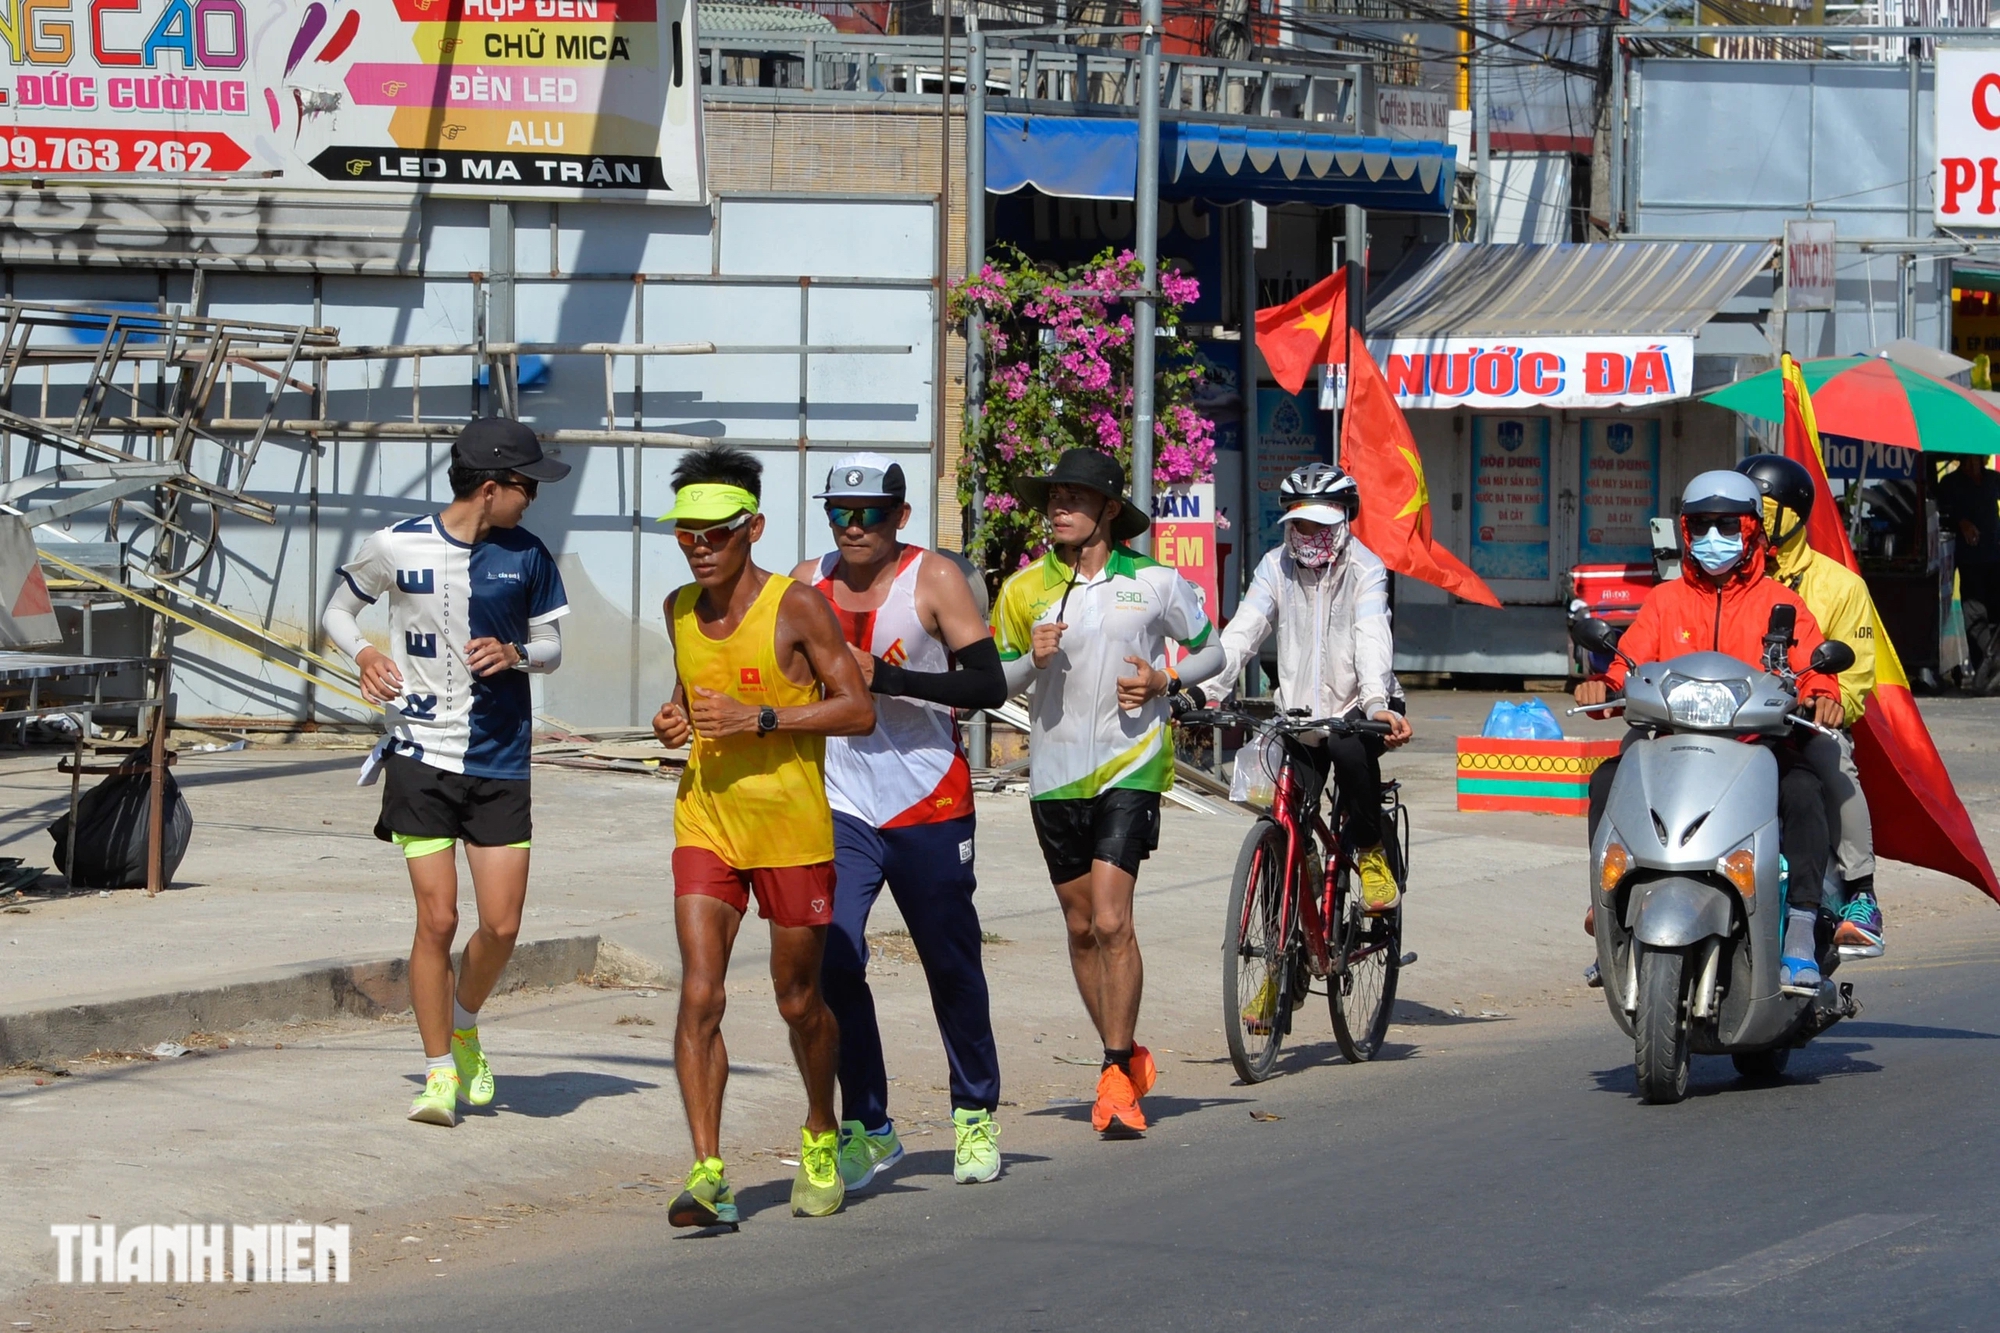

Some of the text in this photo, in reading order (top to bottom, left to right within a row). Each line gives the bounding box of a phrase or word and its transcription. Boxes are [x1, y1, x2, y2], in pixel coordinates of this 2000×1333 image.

[484, 28, 630, 61] CHỮ MICA
[16, 71, 249, 116] ĐỨC CƯỜNG
[450, 66, 578, 103] ĐÈN LED
[1379, 93, 1407, 125] Coffee
[1410, 101, 1428, 127] PHA
[507, 121, 564, 147] ALU
[134, 140, 212, 172] 262
[379, 156, 641, 188] LED MA TRẬN
[1387, 345, 1676, 397] NƯỚC ĐÁ
